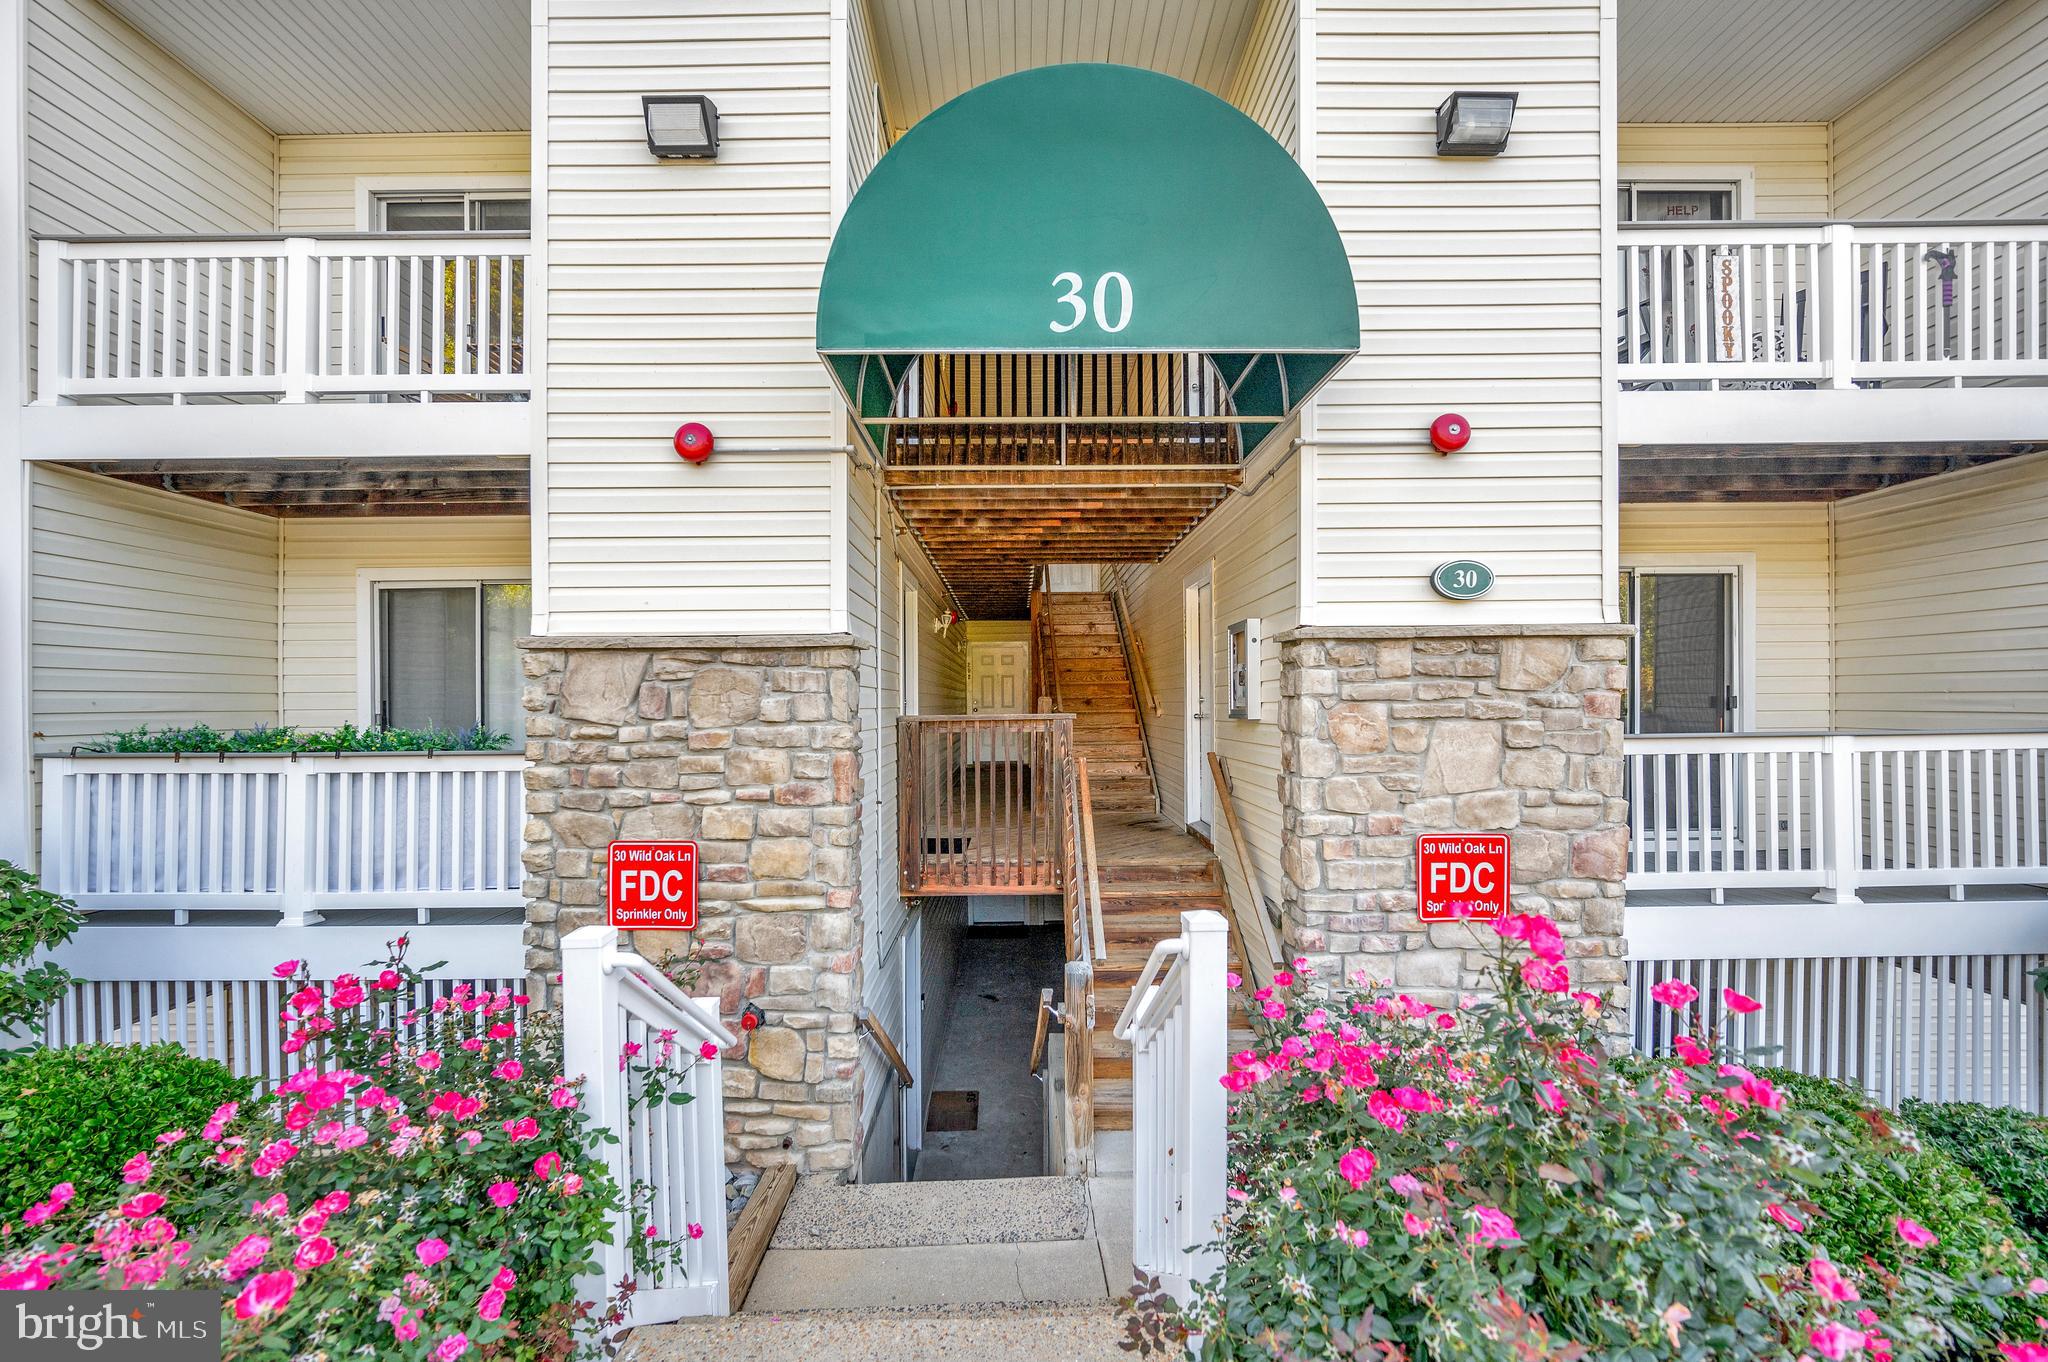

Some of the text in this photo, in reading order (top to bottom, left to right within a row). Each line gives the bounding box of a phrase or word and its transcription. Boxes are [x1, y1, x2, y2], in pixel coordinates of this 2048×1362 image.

[1667, 205, 1699, 216] HELP
[1049, 271, 1133, 333] 30
[1721, 259, 1735, 359] SPOOKY
[1453, 569, 1478, 588] 30
[614, 850, 691, 862] 30 Wild Oak Ln
[1423, 842, 1503, 854] 30 Wild Oak Ln
[620, 869, 683, 902] FDC
[1430, 862, 1495, 894] FDC
[616, 908, 687, 922] Sprinkler Only
[1474, 900, 1499, 914] Only
